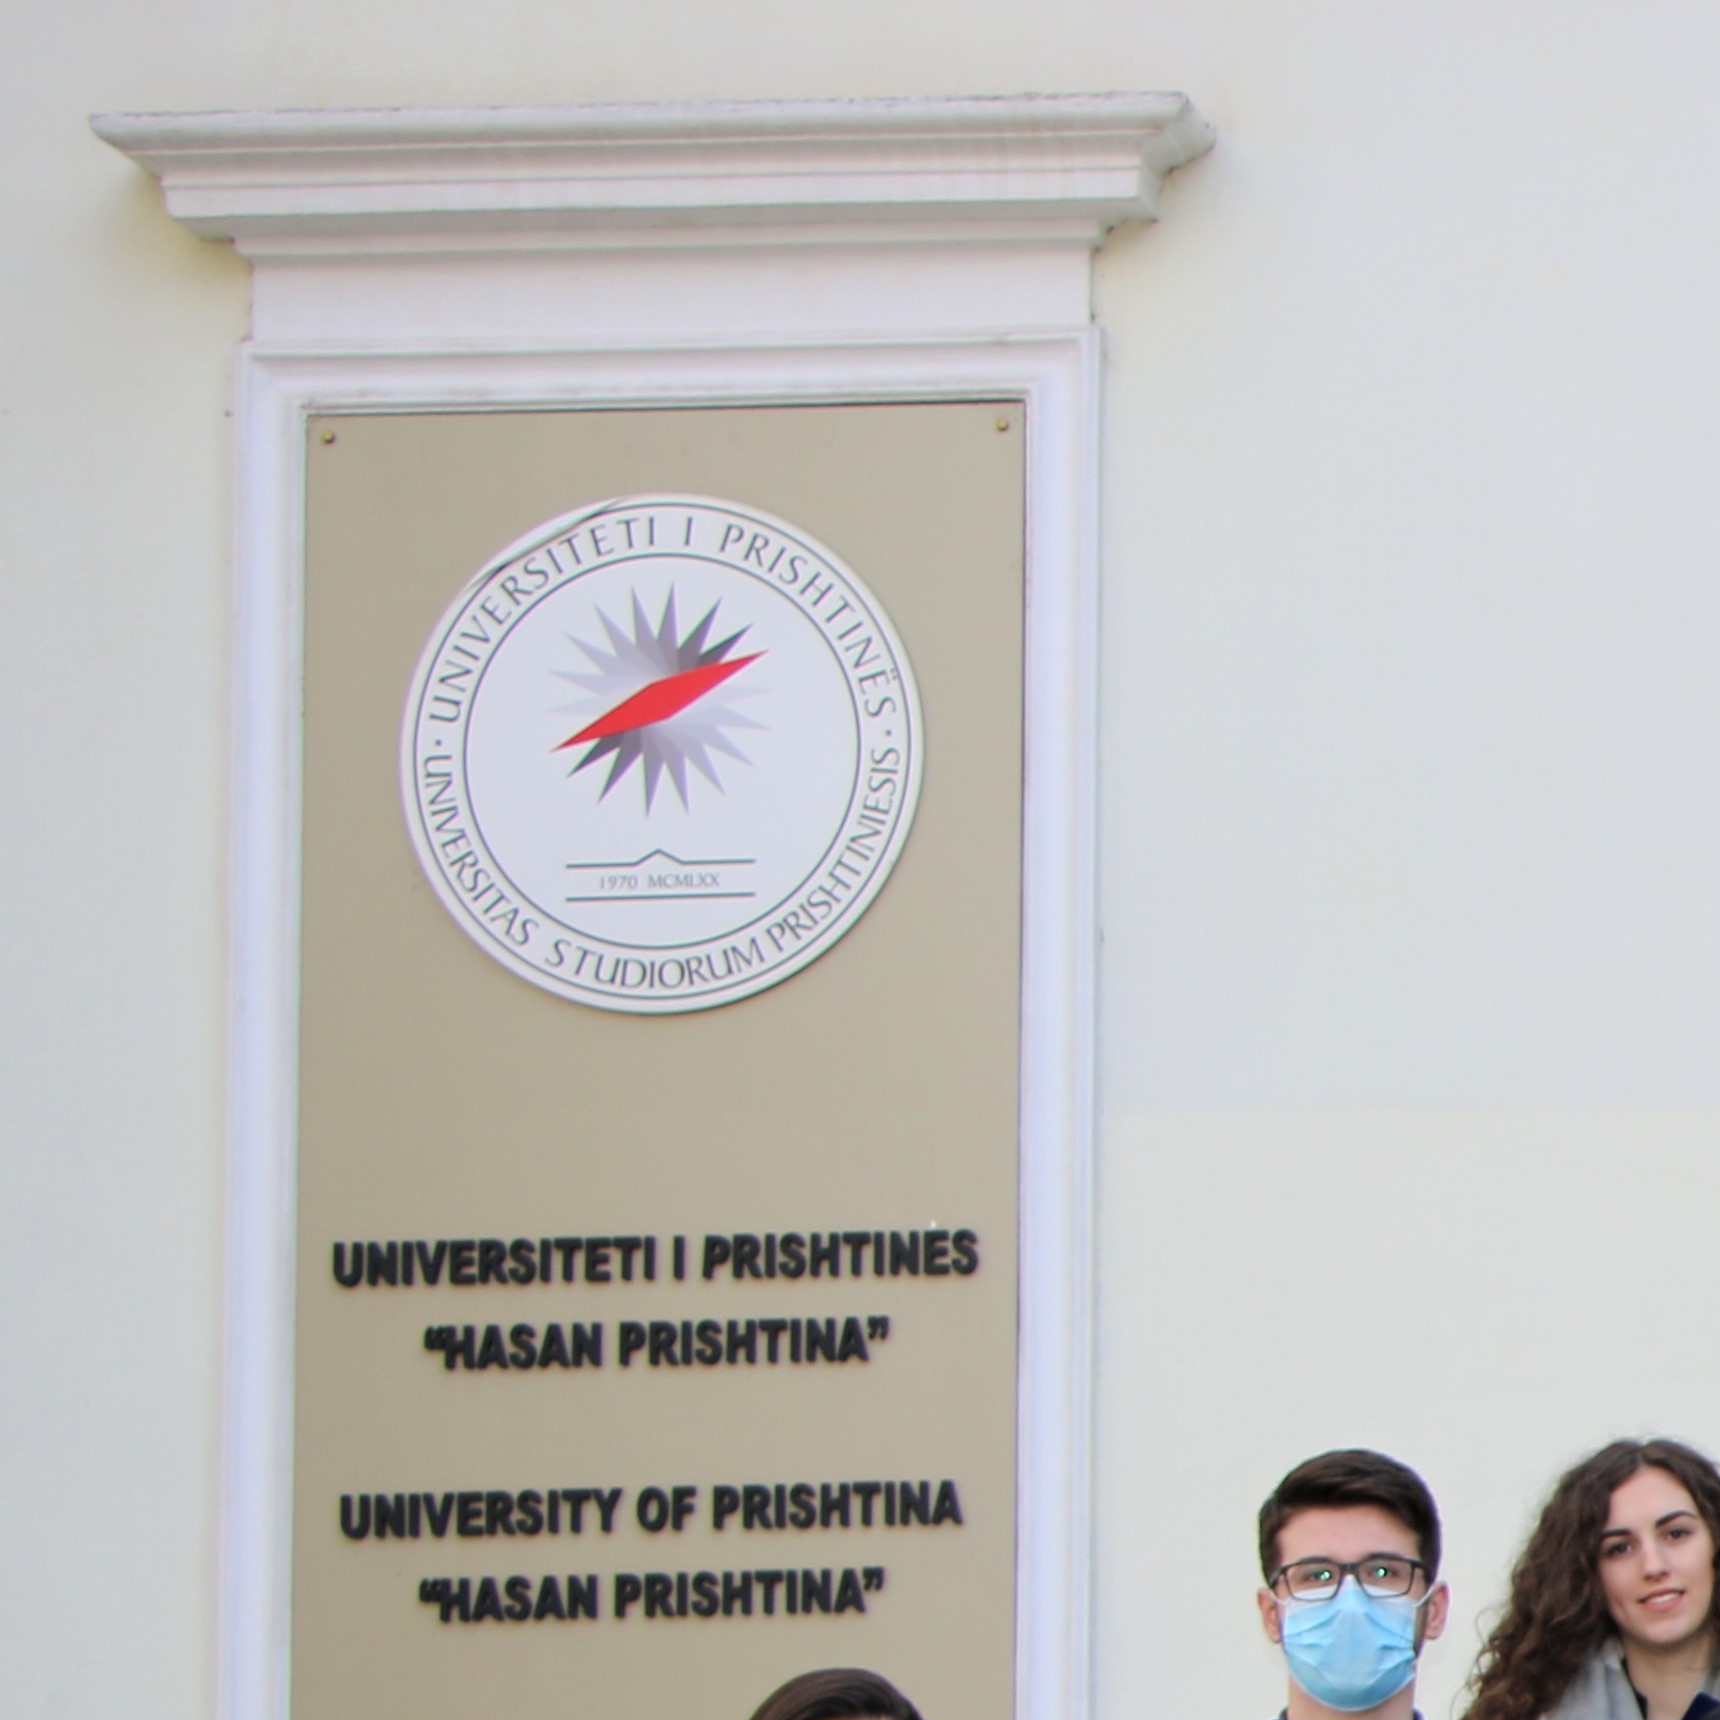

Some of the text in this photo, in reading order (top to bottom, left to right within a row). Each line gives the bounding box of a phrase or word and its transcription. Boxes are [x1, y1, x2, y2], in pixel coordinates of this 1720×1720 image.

[429, 516, 899, 723] UNIVERSITETI I PRISHTINËS
[423, 747, 901, 990] UNIVERSITAS STUDIORUM PRISHTINIESIS
[598, 872, 721, 890] 1970 MCMLXX
[332, 1236, 656, 1289] UNIVERSITETI
[673, 1235, 686, 1282] I
[340, 1480, 963, 1540] UNIVERSITY OF PRISHTINA
